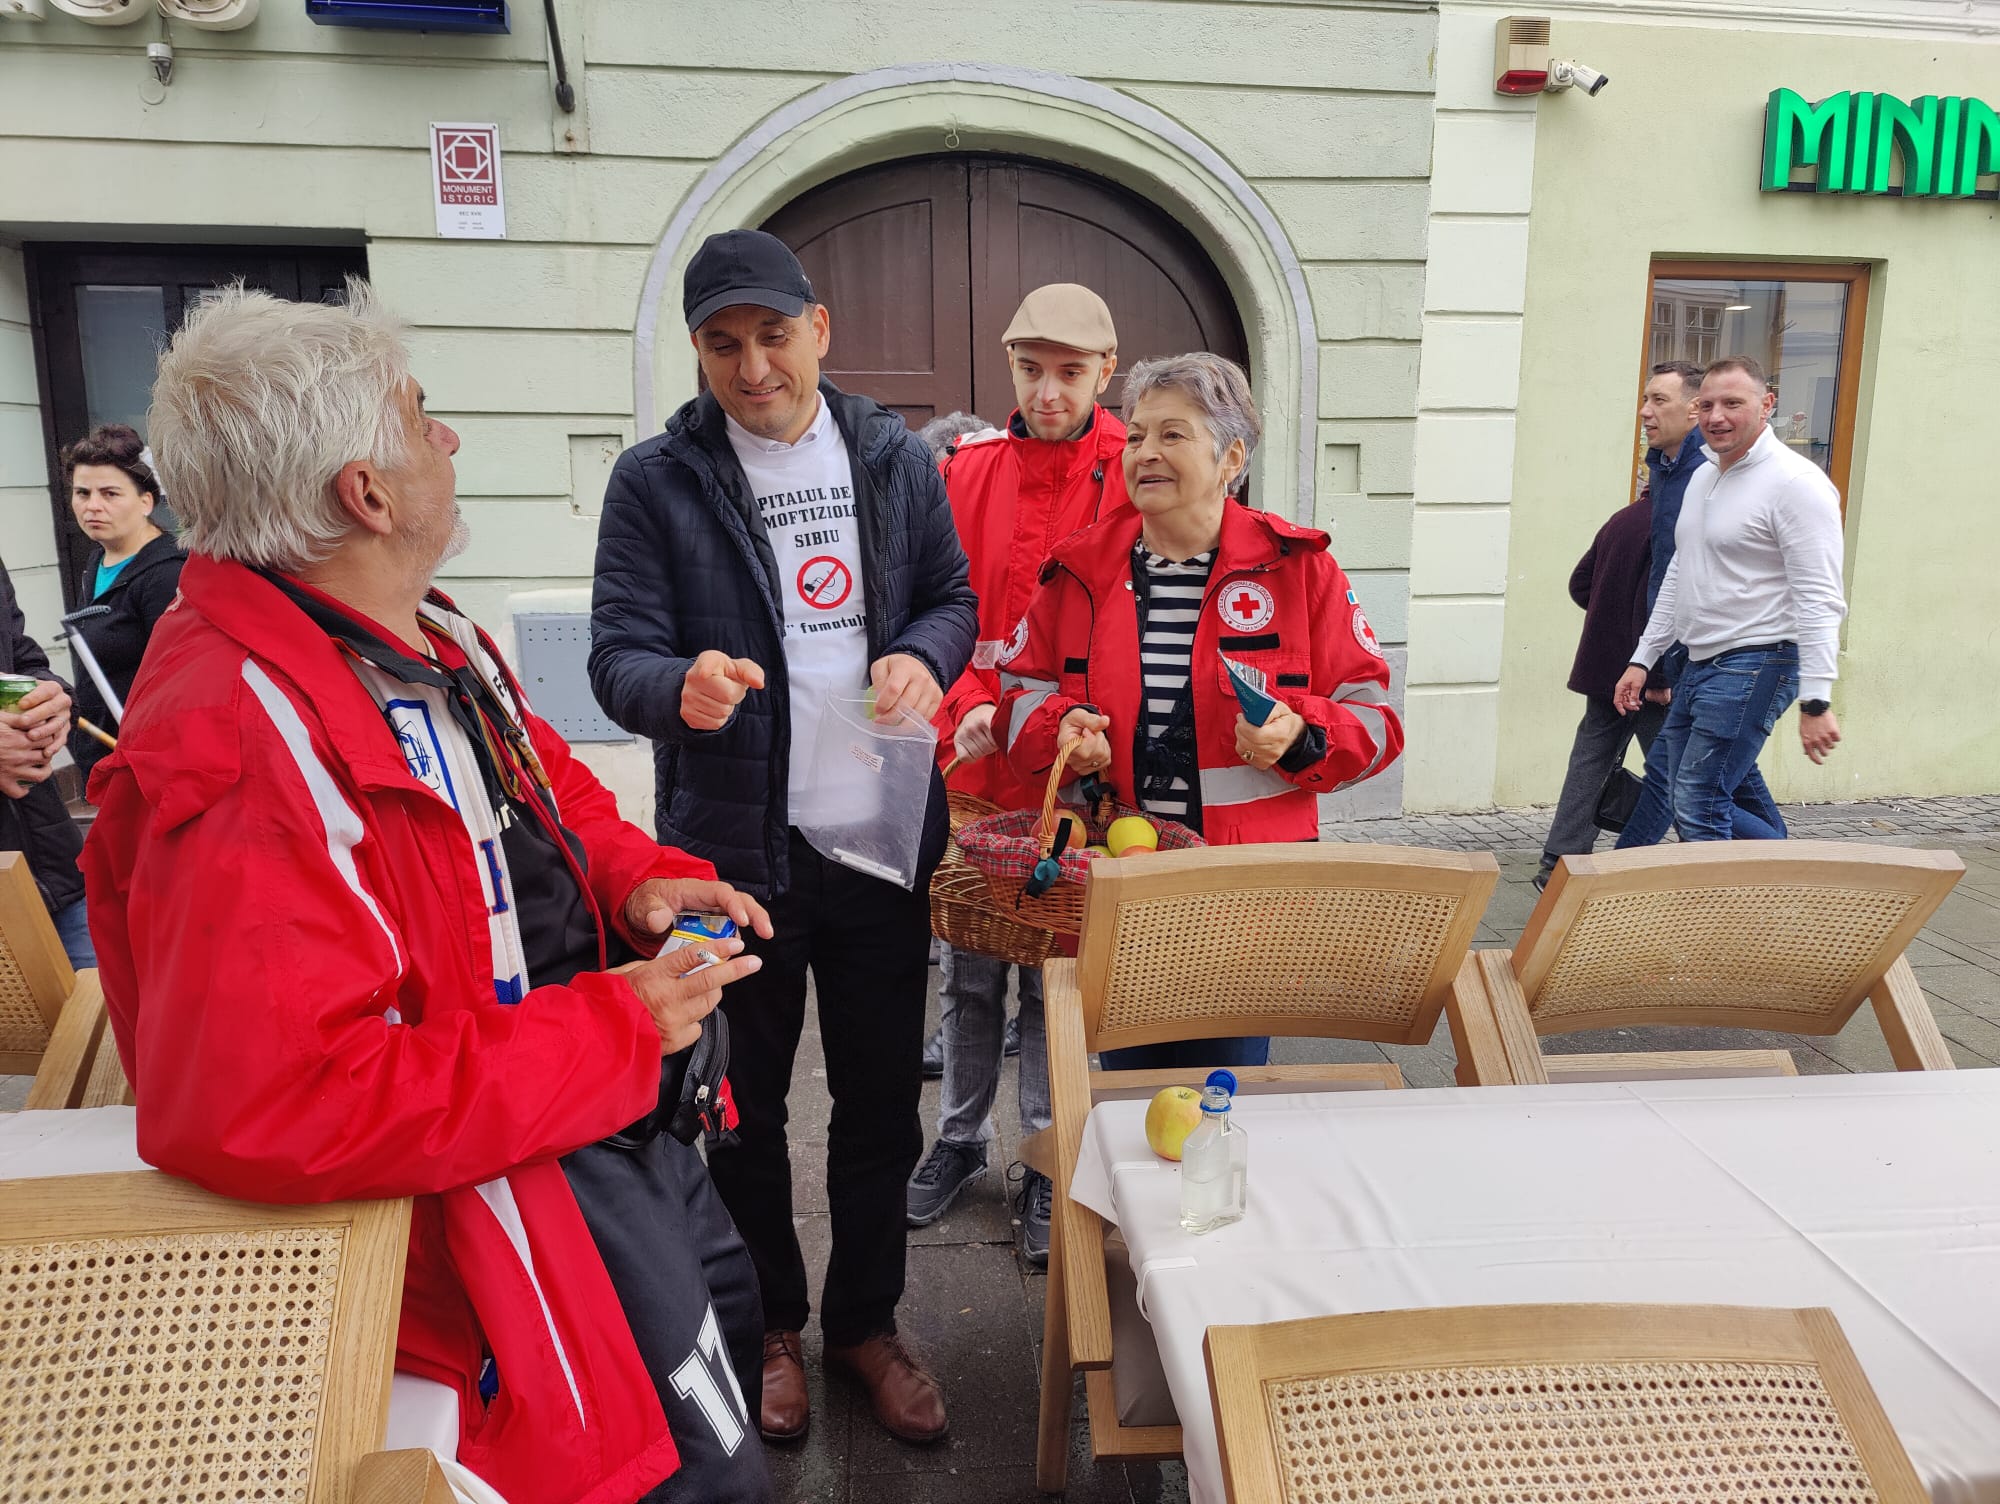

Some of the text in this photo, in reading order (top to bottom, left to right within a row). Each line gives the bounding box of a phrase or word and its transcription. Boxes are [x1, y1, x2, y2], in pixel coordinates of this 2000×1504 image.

[442, 185, 493, 194] MONUMENT
[443, 194, 495, 204] ISTORIC
[830, 486, 851, 501] DE
[794, 529, 840, 548] SIBIU
